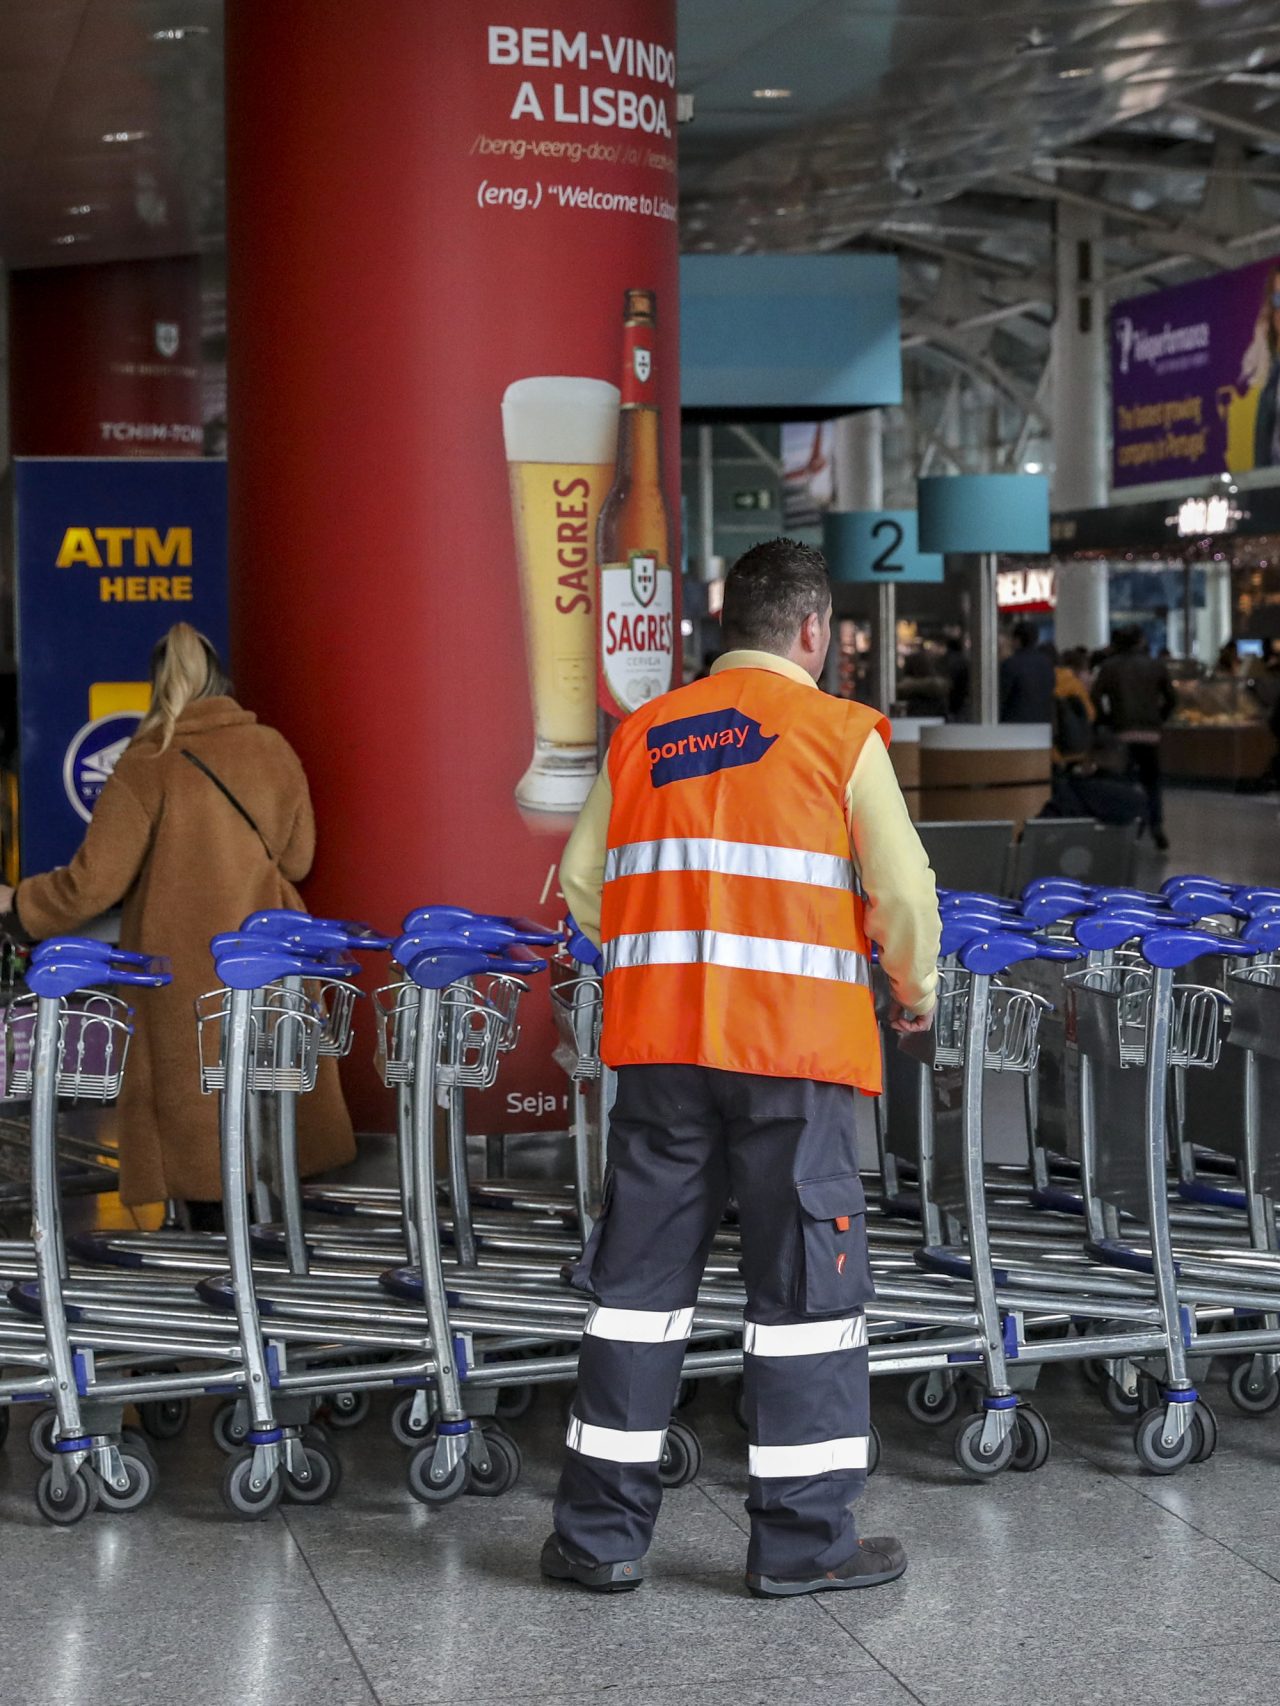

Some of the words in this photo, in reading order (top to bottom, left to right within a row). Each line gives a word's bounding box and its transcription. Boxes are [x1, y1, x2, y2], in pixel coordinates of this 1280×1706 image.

[488, 26, 676, 88] BEM-VINDO
[510, 82, 544, 121] A
[554, 84, 671, 139] LISBOA.
[477, 180, 542, 210] (eng.)
[640, 194, 652, 215] to
[55, 527, 193, 567] ATM
[553, 477, 590, 615] SAGRES
[871, 520, 904, 572] 2
[101, 577, 193, 601] HERE
[606, 611, 673, 655] SAGRES
[648, 725, 750, 770] portway
[506, 1092, 556, 1117] Seja
